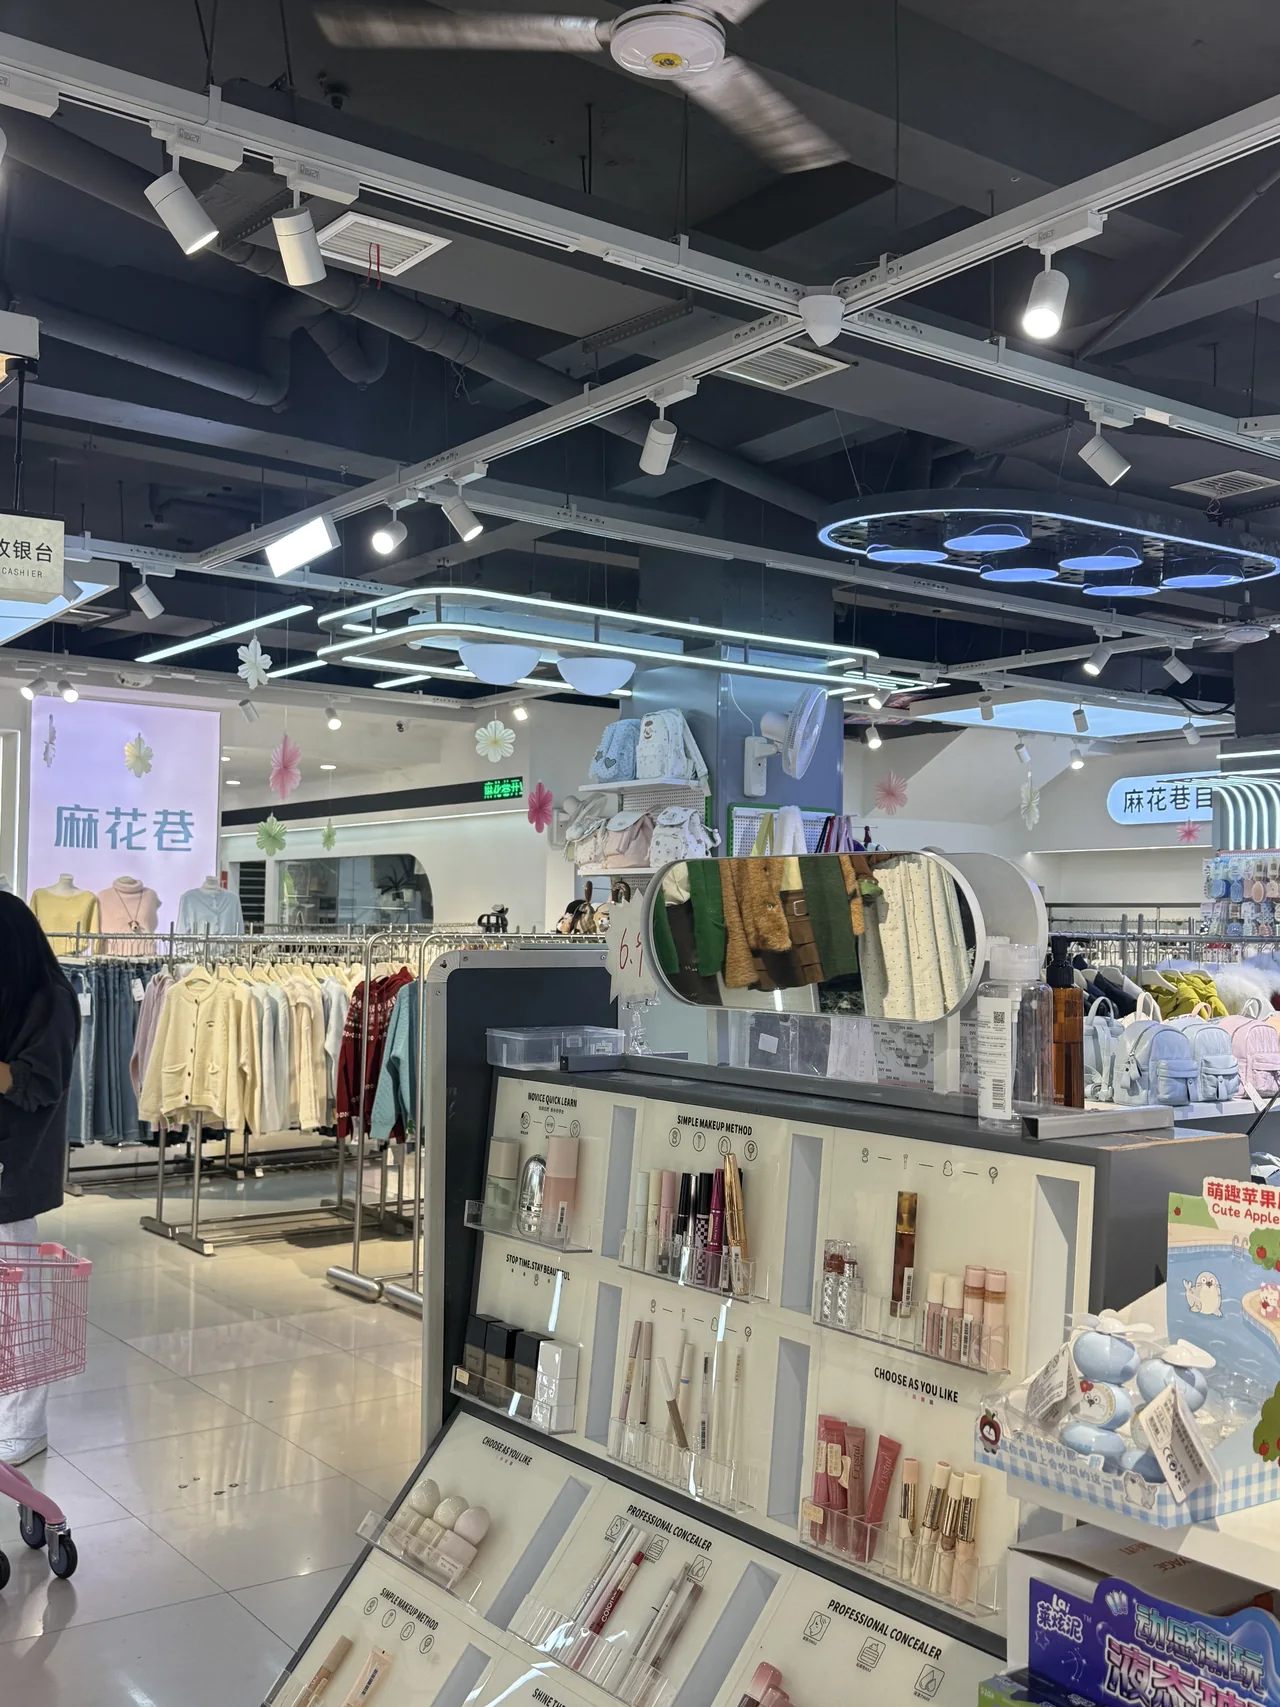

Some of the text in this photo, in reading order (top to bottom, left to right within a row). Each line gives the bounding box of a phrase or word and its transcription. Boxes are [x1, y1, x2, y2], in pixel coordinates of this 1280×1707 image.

[2, 567, 43, 578] CASHIER
[54, 804, 194, 852] 麻花巷
[528, 1092, 577, 1107] NOVICE QUICK LEARN
[677, 1115, 752, 1136] SIMPLE MAKEUP METHOD
[1207, 1182, 1280, 1209] 萌趣苹果
[1212, 1203, 1280, 1224] Cute Apple
[506, 1254, 518, 1264] STOP
[874, 1367, 958, 1403] CHOOSE AS YOU LIKE
[482, 1436, 532, 1466] CHOOSE AS YOU LIKE
[627, 1504, 713, 1552] PROFESSIONAL CONCEALER
[380, 1588, 439, 1631] SIMPLE MAKEUP METHOD
[827, 1599, 942, 1660] PROFESSIONAL CONCEALER
[1134, 1604, 1264, 1696] 动感潮玩
[532, 1688, 553, 1707] SHINE
